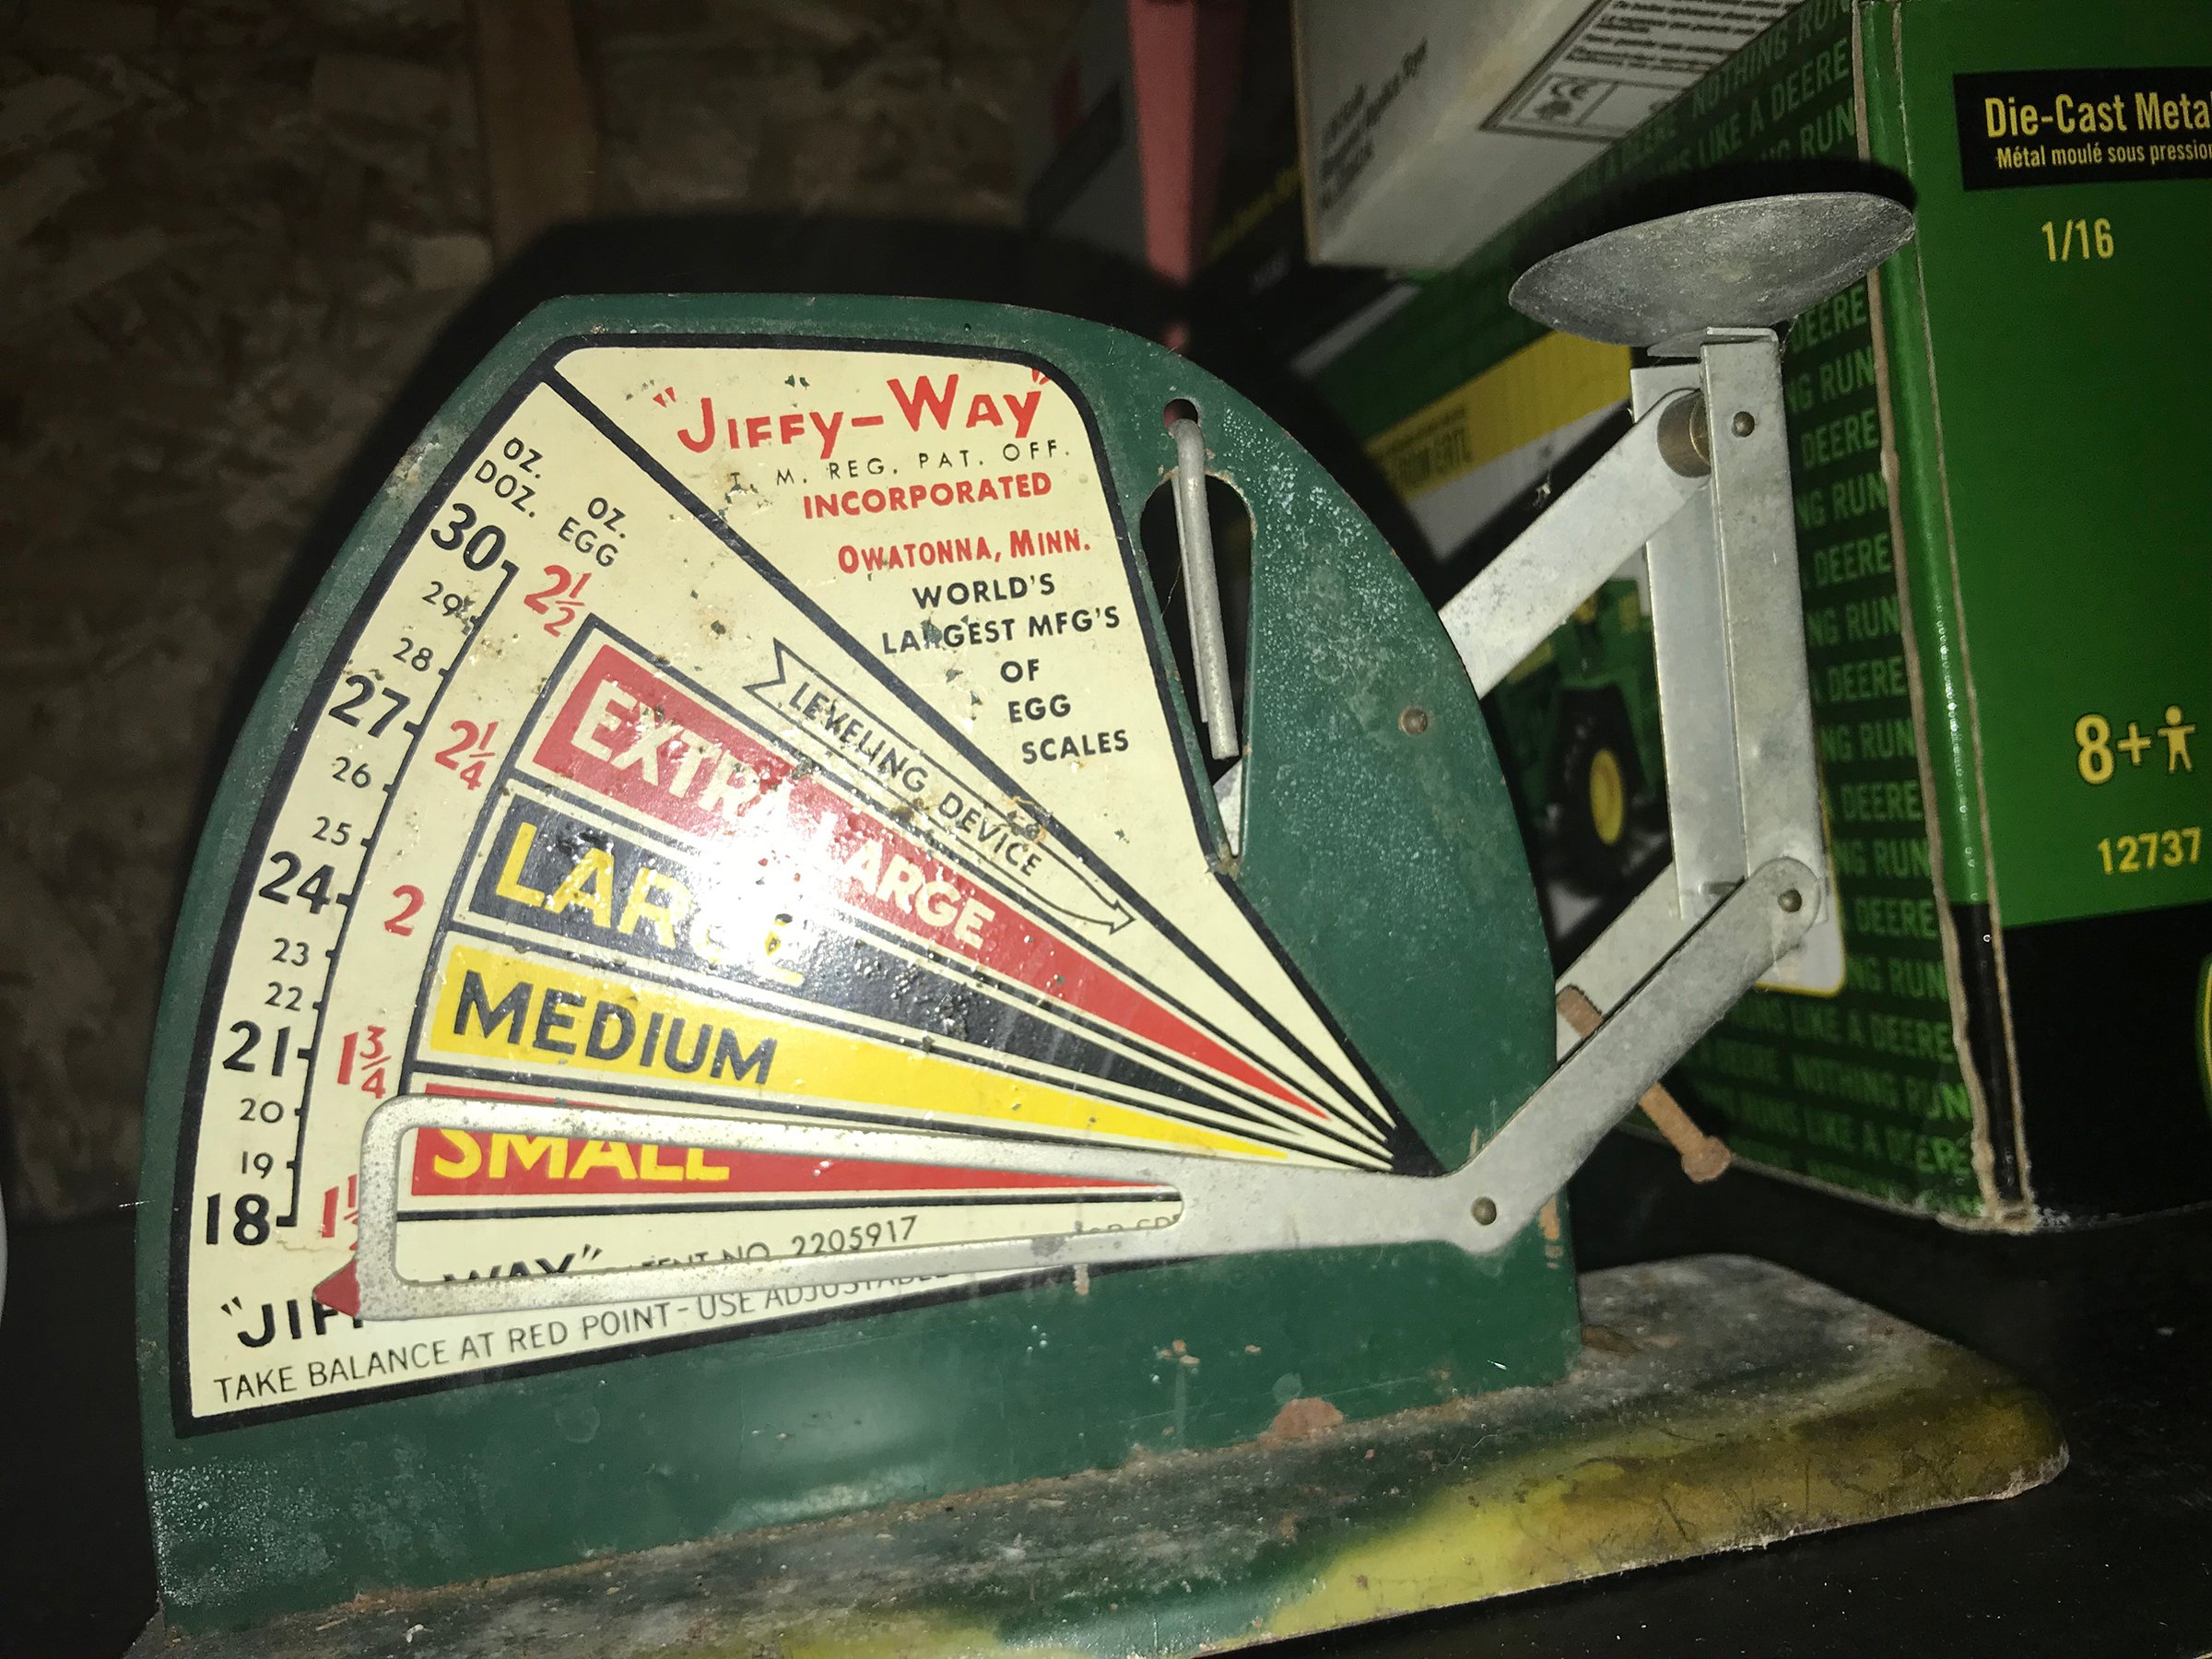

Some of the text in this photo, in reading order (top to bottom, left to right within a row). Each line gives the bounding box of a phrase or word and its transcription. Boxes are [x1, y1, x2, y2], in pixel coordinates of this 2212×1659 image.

[1750, 97, 1766, 140] A
[1770, 38, 1851, 122] DEERE
[1799, 96, 1856, 158] RUN
[1984, 91, 2212, 138] Die-Cast Meta
[1996, 145, 2046, 170] Métal
[2052, 141, 2102, 166] moulé
[2108, 146, 2146, 162] sous
[2041, 218, 2115, 263] 1/16
[1819, 346, 1876, 401] RUN
[502, 438, 542, 479] OZ.
[830, 456, 899, 478] REG.
[919, 450, 984, 470] PAT.
[1002, 439, 1071, 463] OFF.
[1800, 407, 1880, 470] DEERE
[475, 460, 536, 518] DOZ.
[803, 472, 1053, 520] INCORPORATED
[1831, 472, 1889, 524] RUN
[430, 503, 507, 571] 30
[587, 498, 627, 539] OZ.
[558, 518, 619, 568] EGG
[1813, 533, 1891, 588] DEERE
[422, 581, 464, 617] 29
[912, 572, 1056, 609] WORLD'S
[1028, 606, 1122, 635] MFG'S
[1845, 594, 1902, 642] RUN
[393, 637, 435, 671] 28
[1000, 659, 1041, 683] OF
[1828, 655, 1907, 702] DEERE
[328, 674, 411, 738] 27
[1007, 693, 1073, 724] EGG
[1021, 729, 1130, 764] SCALES
[2074, 713, 2152, 785] 8+
[333, 756, 371, 789] 26
[788, 682, 1044, 877] LEVELING DEVICE
[312, 816, 352, 845] 25
[2097, 826, 2202, 876] 12737
[259, 851, 335, 914] 24
[383, 885, 425, 936] 2
[273, 937, 310, 966] 23
[265, 982, 302, 1011] 22
[223, 1020, 291, 1077] 21
[453, 969, 778, 1085] MEDIUM
[1869, 1013, 1955, 1063] DEERE
[240, 1099, 284, 1124] 20
[241, 1151, 274, 1178] 19
[434, 1128, 730, 1181] SMALL
[206, 1193, 271, 1245] 18
[792, 1215, 917, 1255] 2205917
[214, 1366, 298, 1404] TAKE
[309, 1342, 450, 1388] BALANCE
[460, 1330, 494, 1362] AT
[510, 1321, 569, 1352] RED
